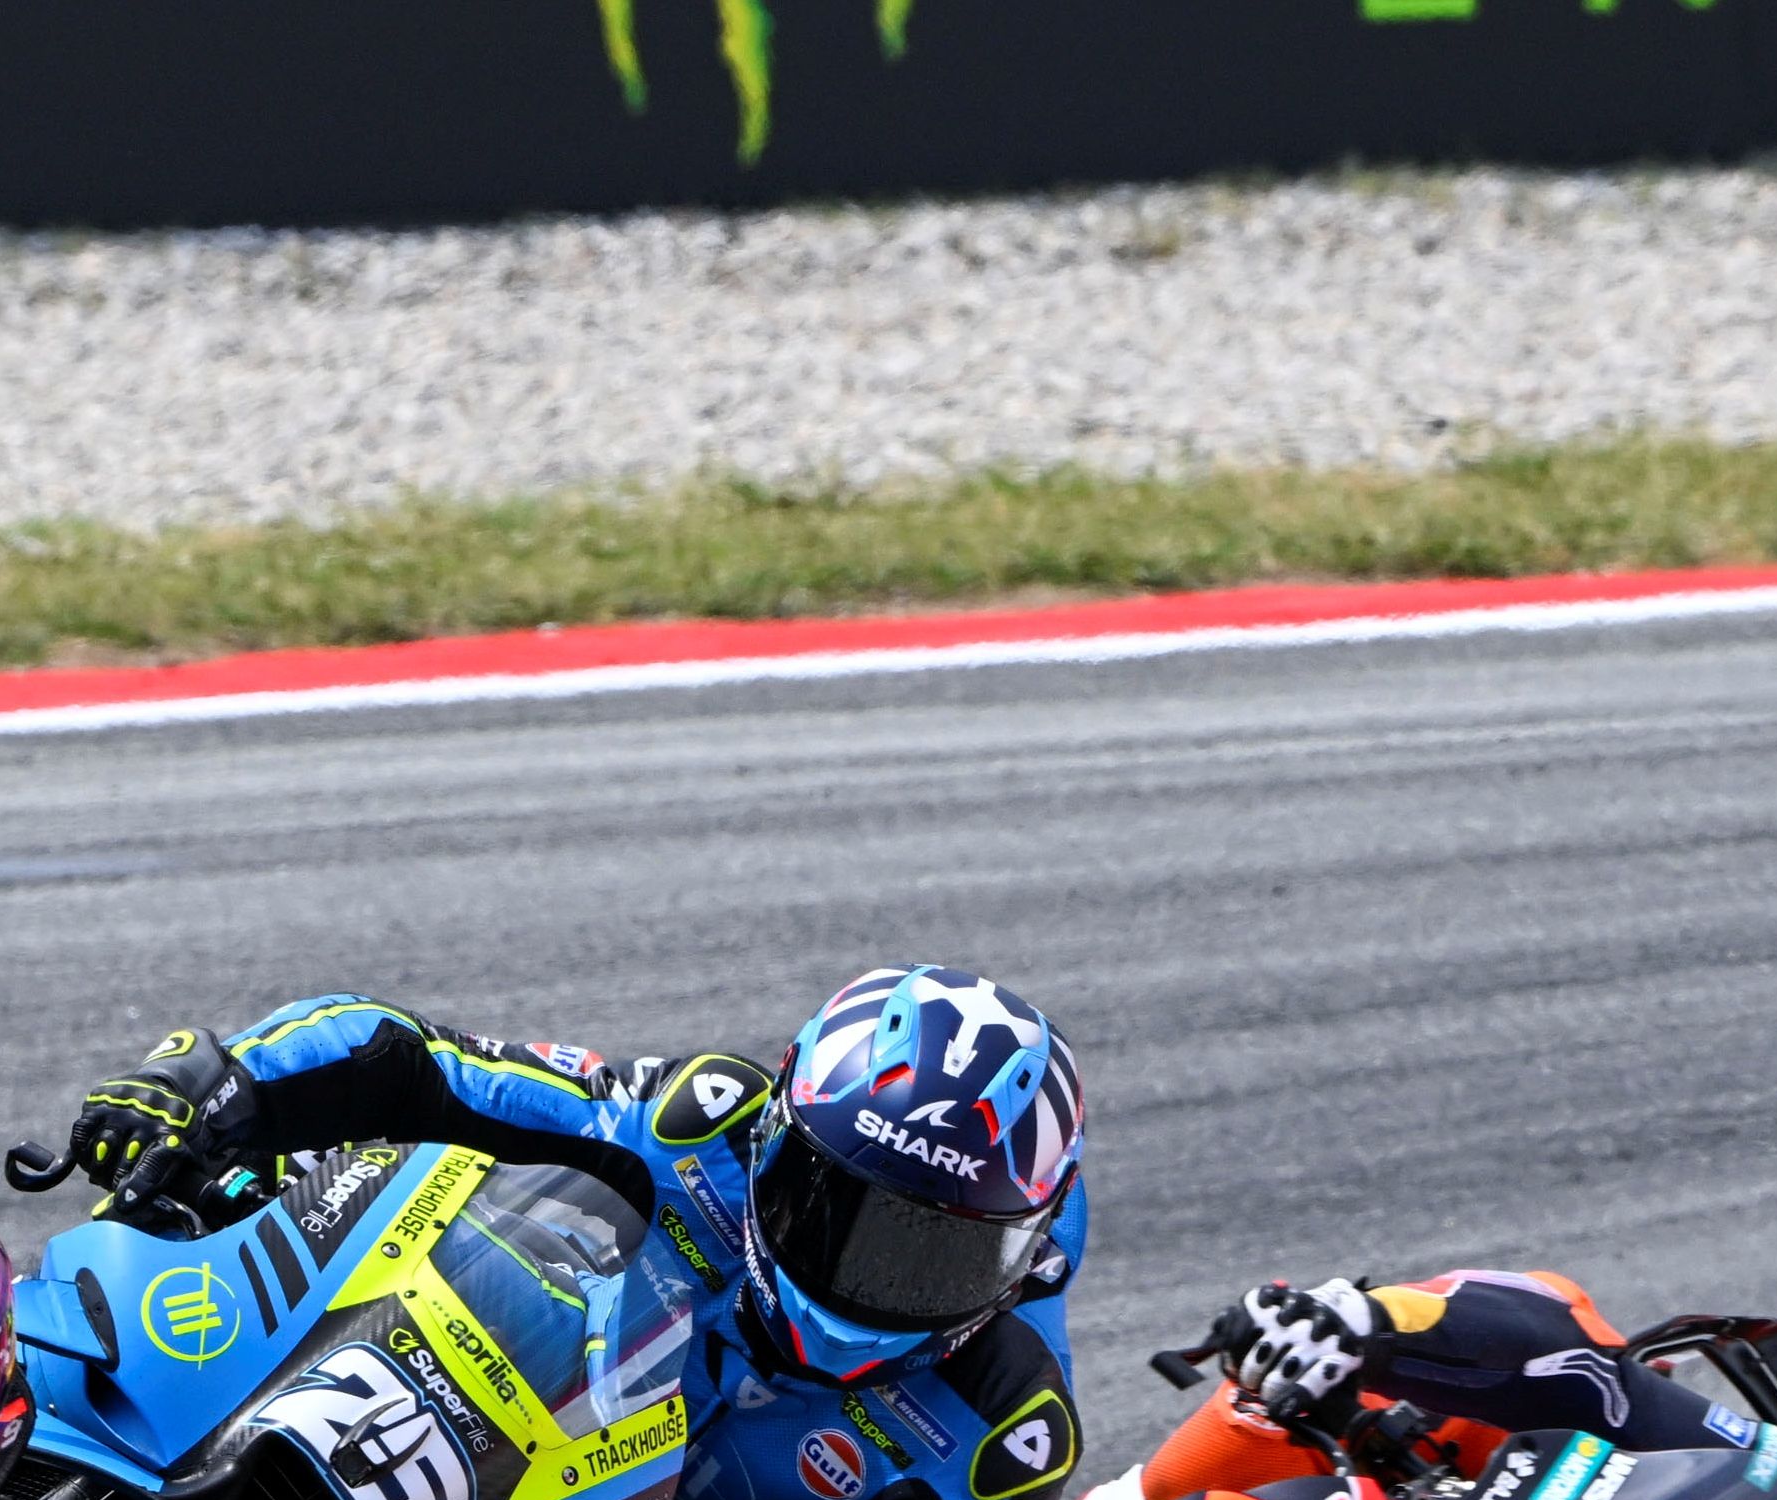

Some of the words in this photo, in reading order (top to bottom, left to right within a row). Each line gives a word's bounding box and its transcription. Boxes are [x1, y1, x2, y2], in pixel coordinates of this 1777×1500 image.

[853, 1108, 988, 1182] SHARK
[395, 1152, 475, 1244] TRACKHOUSE
[695, 1187, 744, 1248] MICHELIN
[445, 1318, 521, 1404] aprilia
[409, 1347, 492, 1453] SuperFile
[896, 1399, 947, 1450] MICHELIN
[583, 1413, 687, 1478] TRACKHOUSE
[802, 1438, 862, 1498] Gulf
